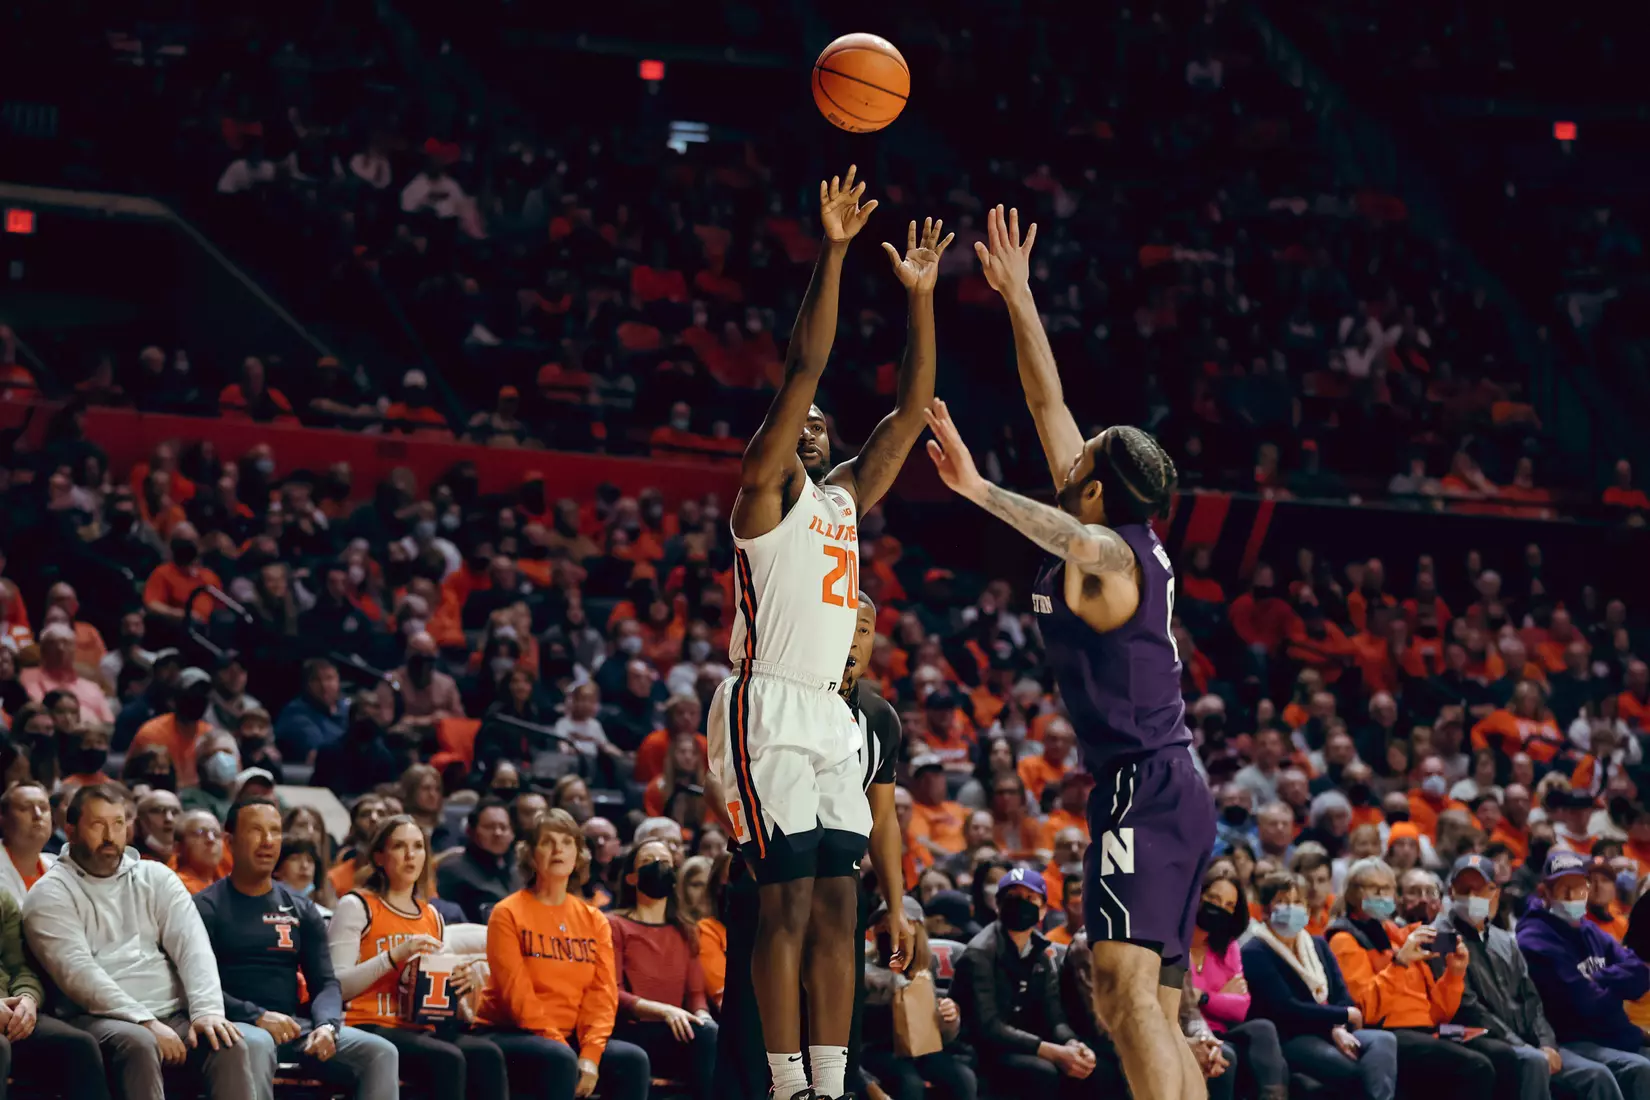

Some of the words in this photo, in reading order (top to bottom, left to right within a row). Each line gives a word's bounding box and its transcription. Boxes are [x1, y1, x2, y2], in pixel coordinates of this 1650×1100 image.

[822, 544, 859, 609] 20
[1101, 828, 1135, 877] N
[1010, 868, 1025, 881] N
[423, 971, 453, 1009] I
